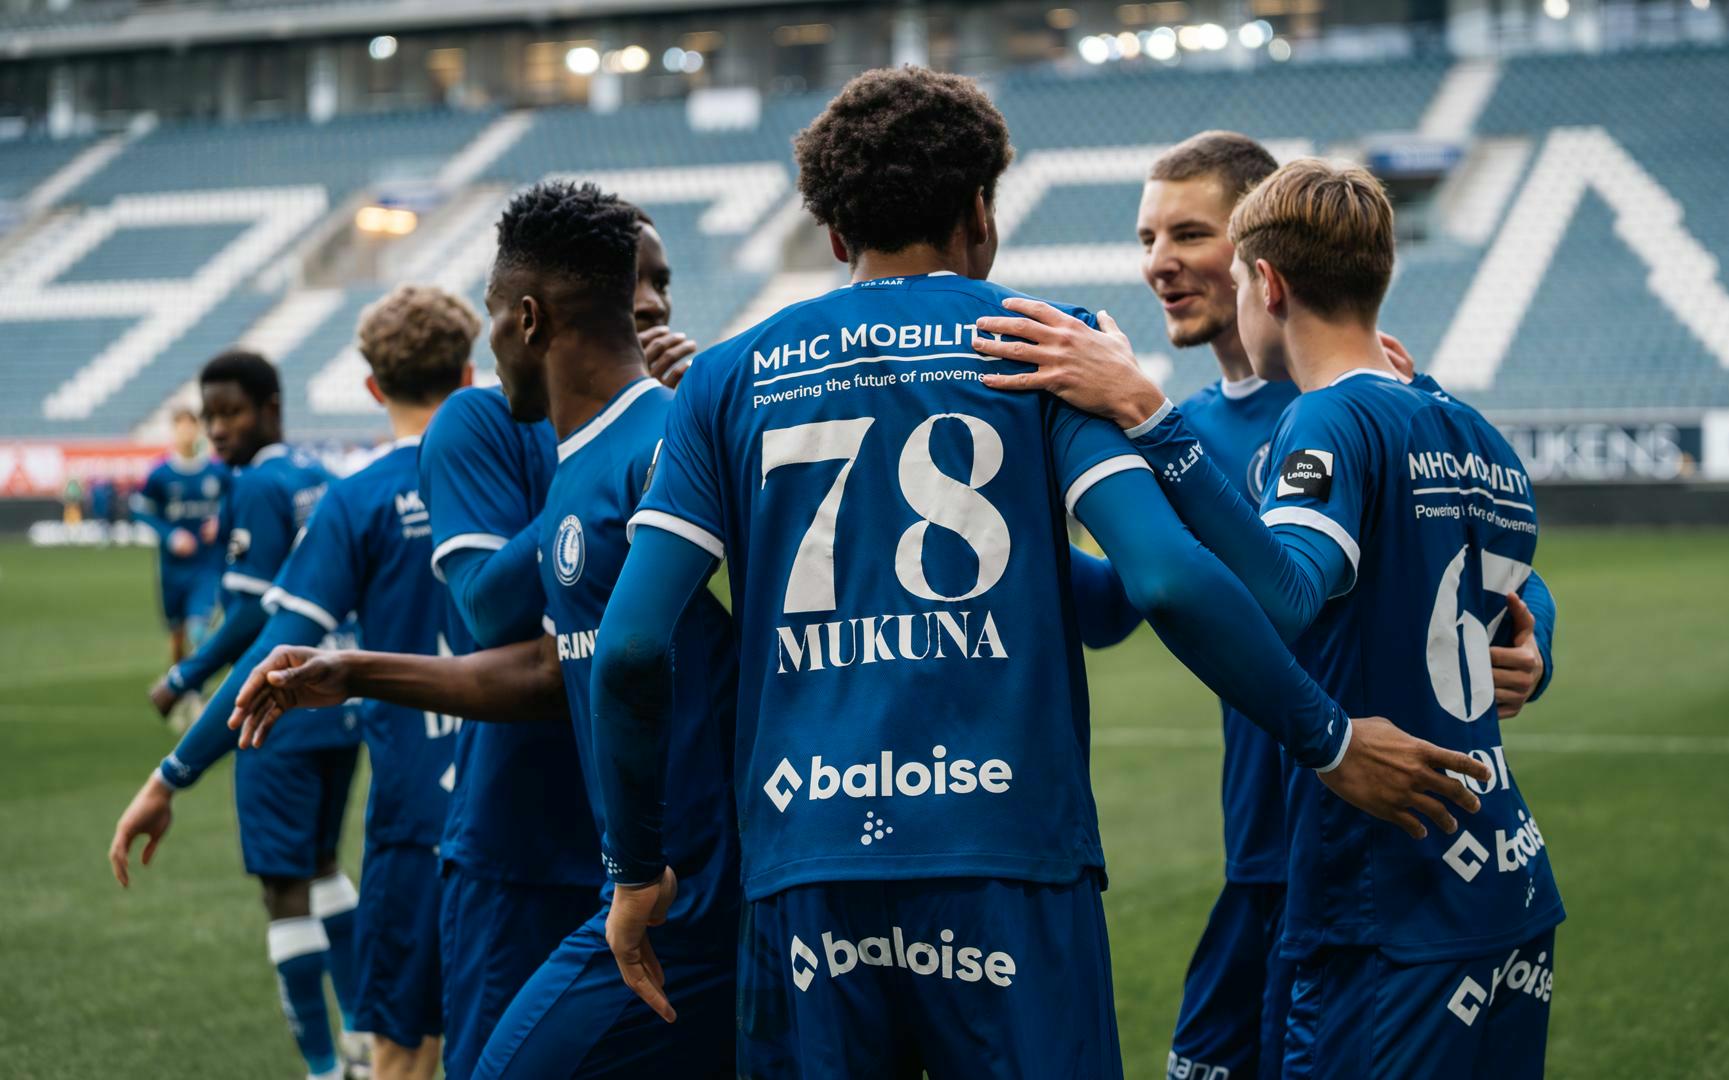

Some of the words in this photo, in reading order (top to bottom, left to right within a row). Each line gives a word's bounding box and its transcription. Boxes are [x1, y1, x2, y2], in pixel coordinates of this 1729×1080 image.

[753, 333, 830, 375] MHC
[753, 383, 823, 409] Powering
[826, 377, 851, 392] the
[854, 371, 897, 388] future
[900, 368, 917, 383] of
[919, 368, 1000, 384] moveme
[1286, 471, 1323, 479] League
[1296, 462, 1314, 470] Pro
[1408, 451, 1458, 480] MHC
[761, 412, 1011, 614] 78
[1415, 503, 1460, 519] Powering
[775, 609, 1010, 675] MUKUNA
[808, 744, 1013, 801] baloise
[821, 926, 1017, 987] baloise
